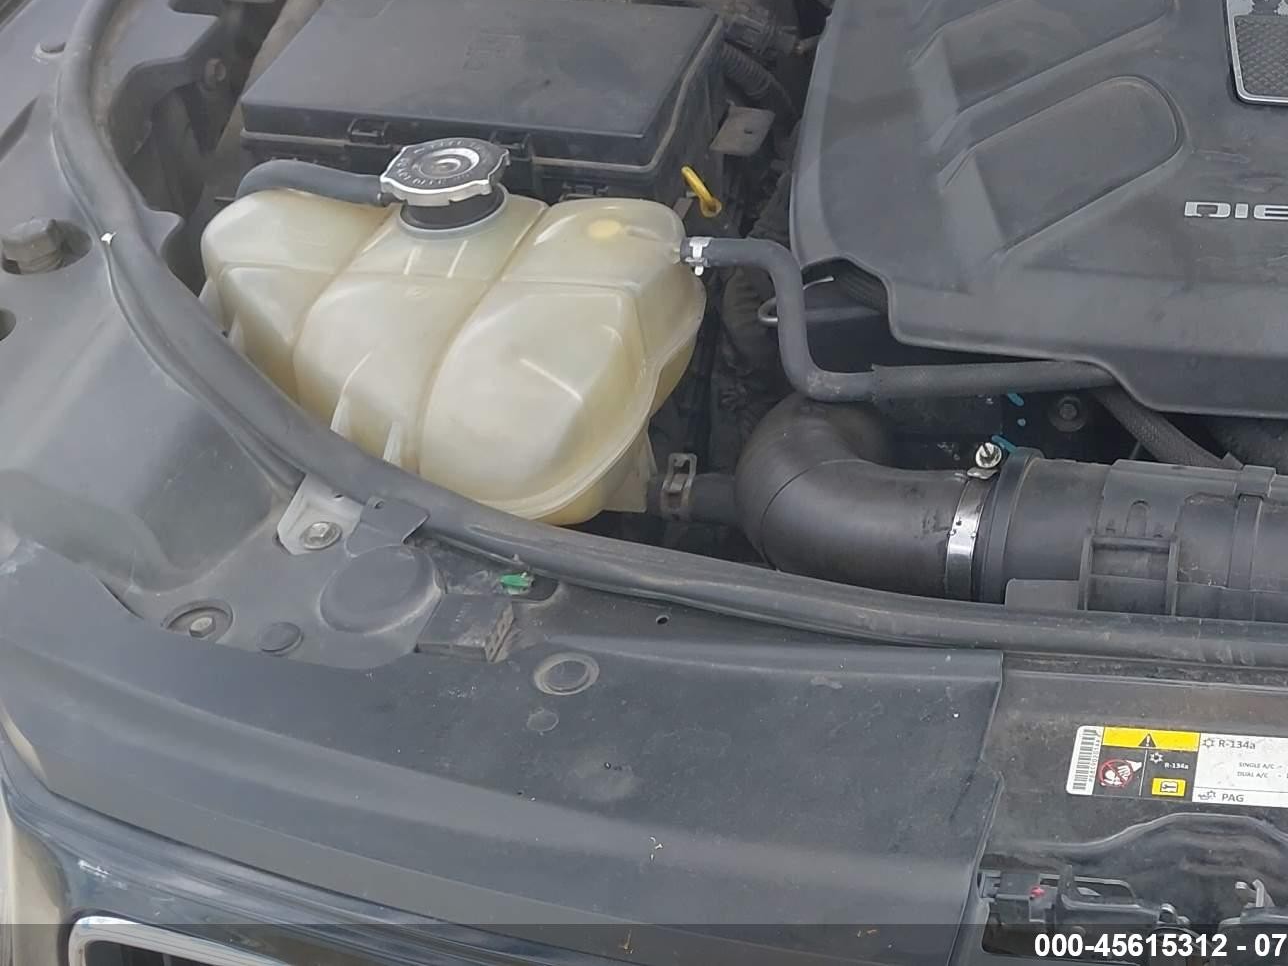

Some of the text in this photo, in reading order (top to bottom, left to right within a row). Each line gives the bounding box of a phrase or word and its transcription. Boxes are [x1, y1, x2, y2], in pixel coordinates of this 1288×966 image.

[1218, 739, 1256, 750] R-134a
[1164, 762, 1190, 770] R-134a
[1238, 761, 1261, 769] SINGLE
[1262, 762, 1275, 770] A/C
[1221, 794, 1245, 803] PAG
